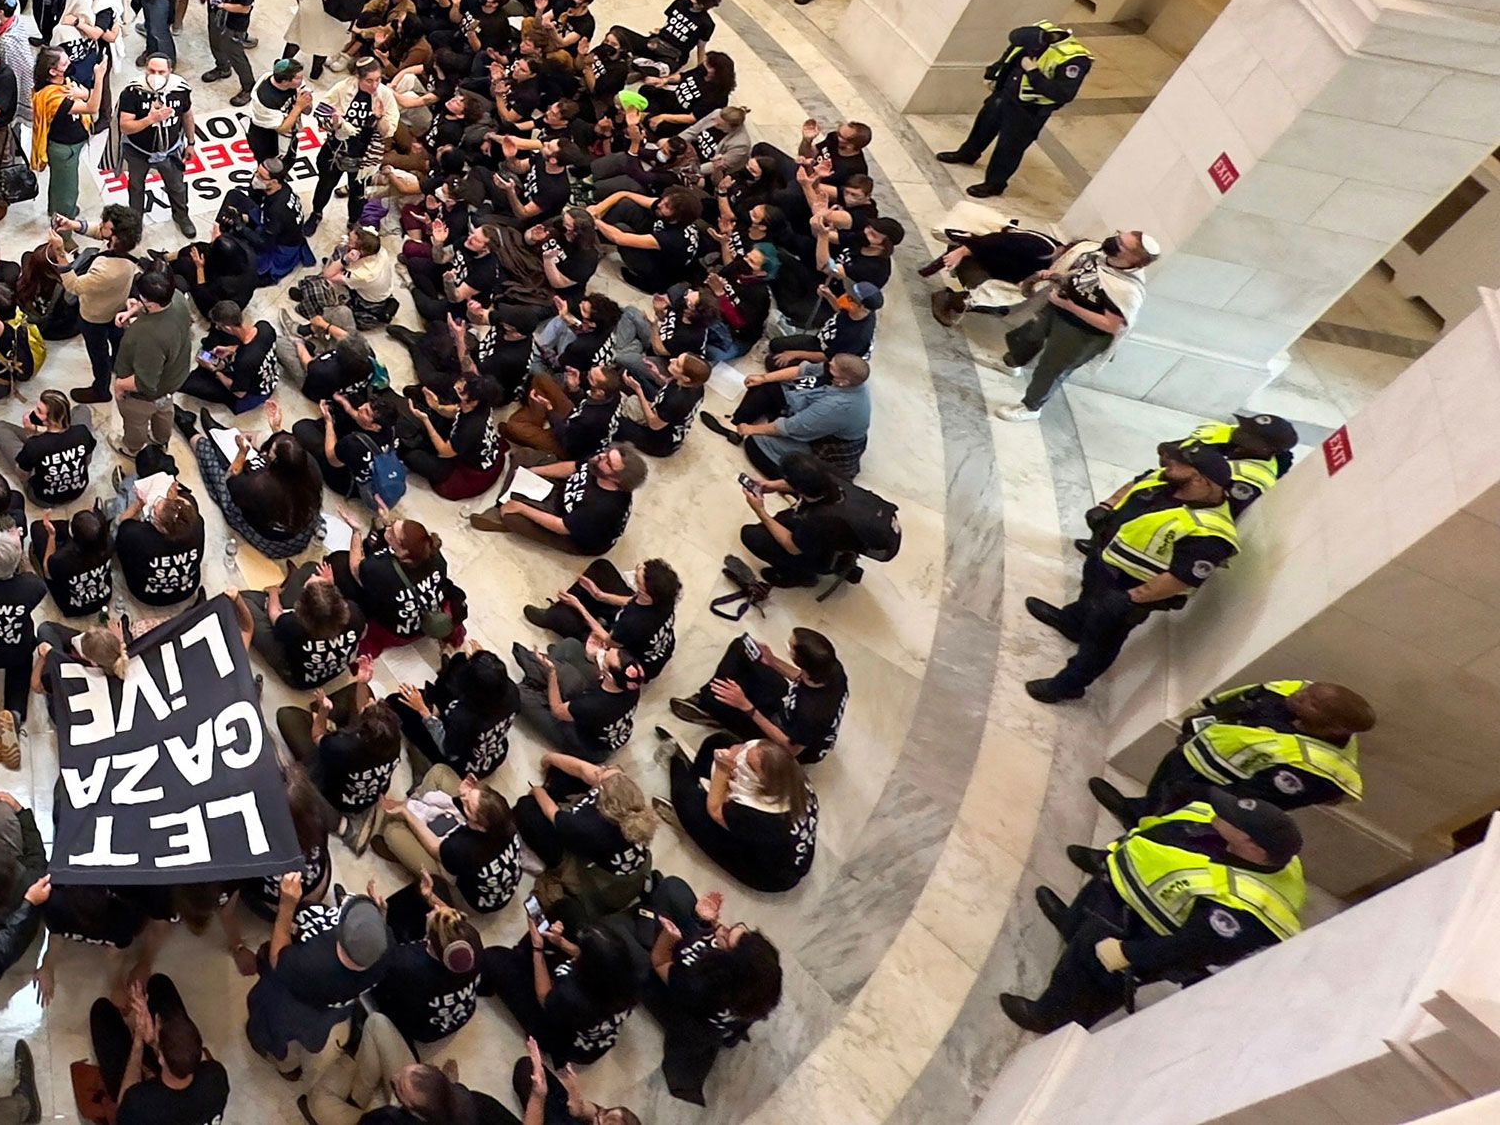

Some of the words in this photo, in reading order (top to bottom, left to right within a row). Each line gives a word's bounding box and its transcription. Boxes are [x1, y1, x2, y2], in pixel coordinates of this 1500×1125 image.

[669, 17, 690, 35] OUR
[686, 19, 698, 31] IN
[1214, 159, 1234, 185] EXIT
[144, 177, 222, 213] SY
[41, 445, 86, 467] JEWS
[1328, 433, 1346, 467] EXIT
[48, 457, 82, 477] SAY
[43, 479, 87, 497] NOW
[150, 549, 198, 568] JEWS
[302, 630, 357, 653] JEWS
[310, 646, 353, 663] SAY
[60, 700, 263, 809] GAZA
[68, 791, 270, 868] LET
[478, 834, 520, 878] JEWS
